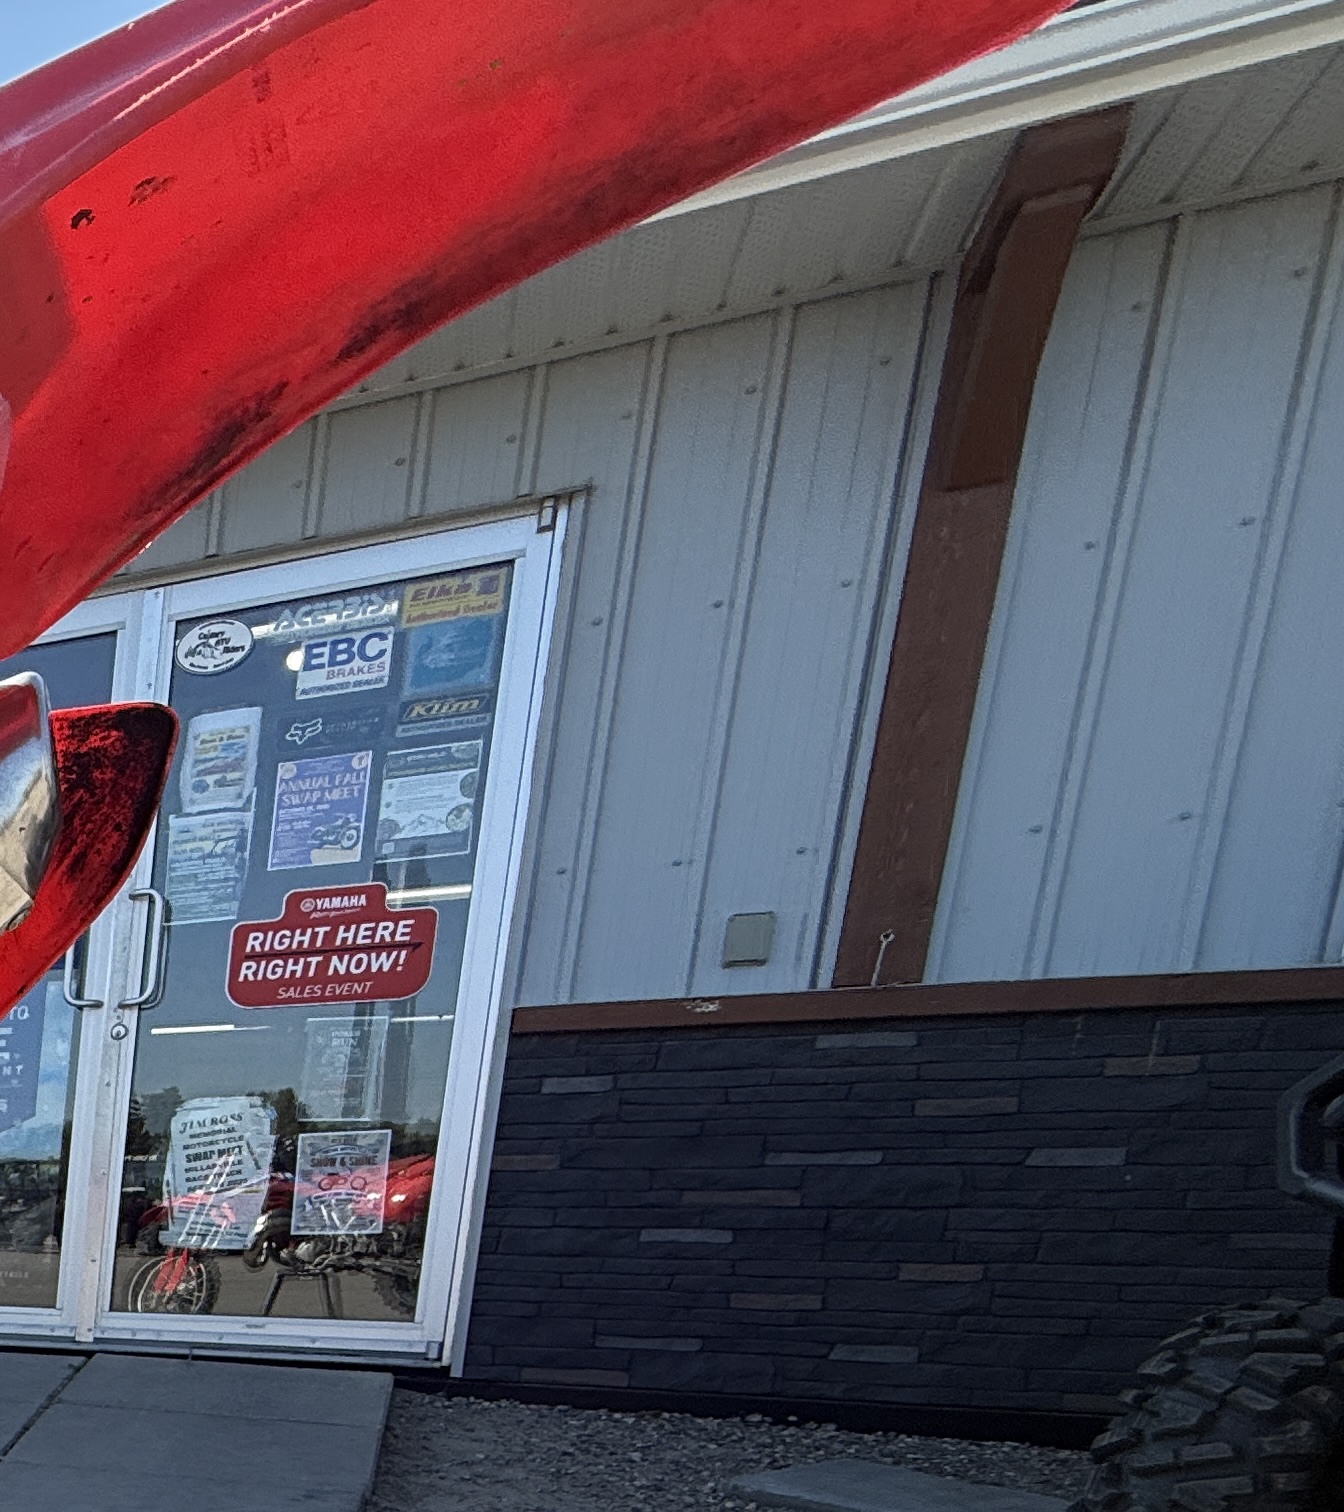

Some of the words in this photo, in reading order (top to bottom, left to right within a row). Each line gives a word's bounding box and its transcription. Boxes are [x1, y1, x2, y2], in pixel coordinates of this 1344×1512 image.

[302, 632, 389, 672] EBC
[326, 662, 386, 680] BRAKES
[279, 774, 333, 792] ANNUAL
[282, 790, 321, 807] SWAP
[324, 785, 361, 801] MEET
[316, 894, 366, 910] YAMAHA
[245, 926, 331, 953] RIGHT
[335, 919, 415, 946] HERE
[238, 955, 322, 982] RIGHT
[327, 950, 408, 976] NOW!
[276, 984, 322, 999] SALES
[325, 981, 374, 996] EVENT
[185, 1150, 216, 1164] SWAP
